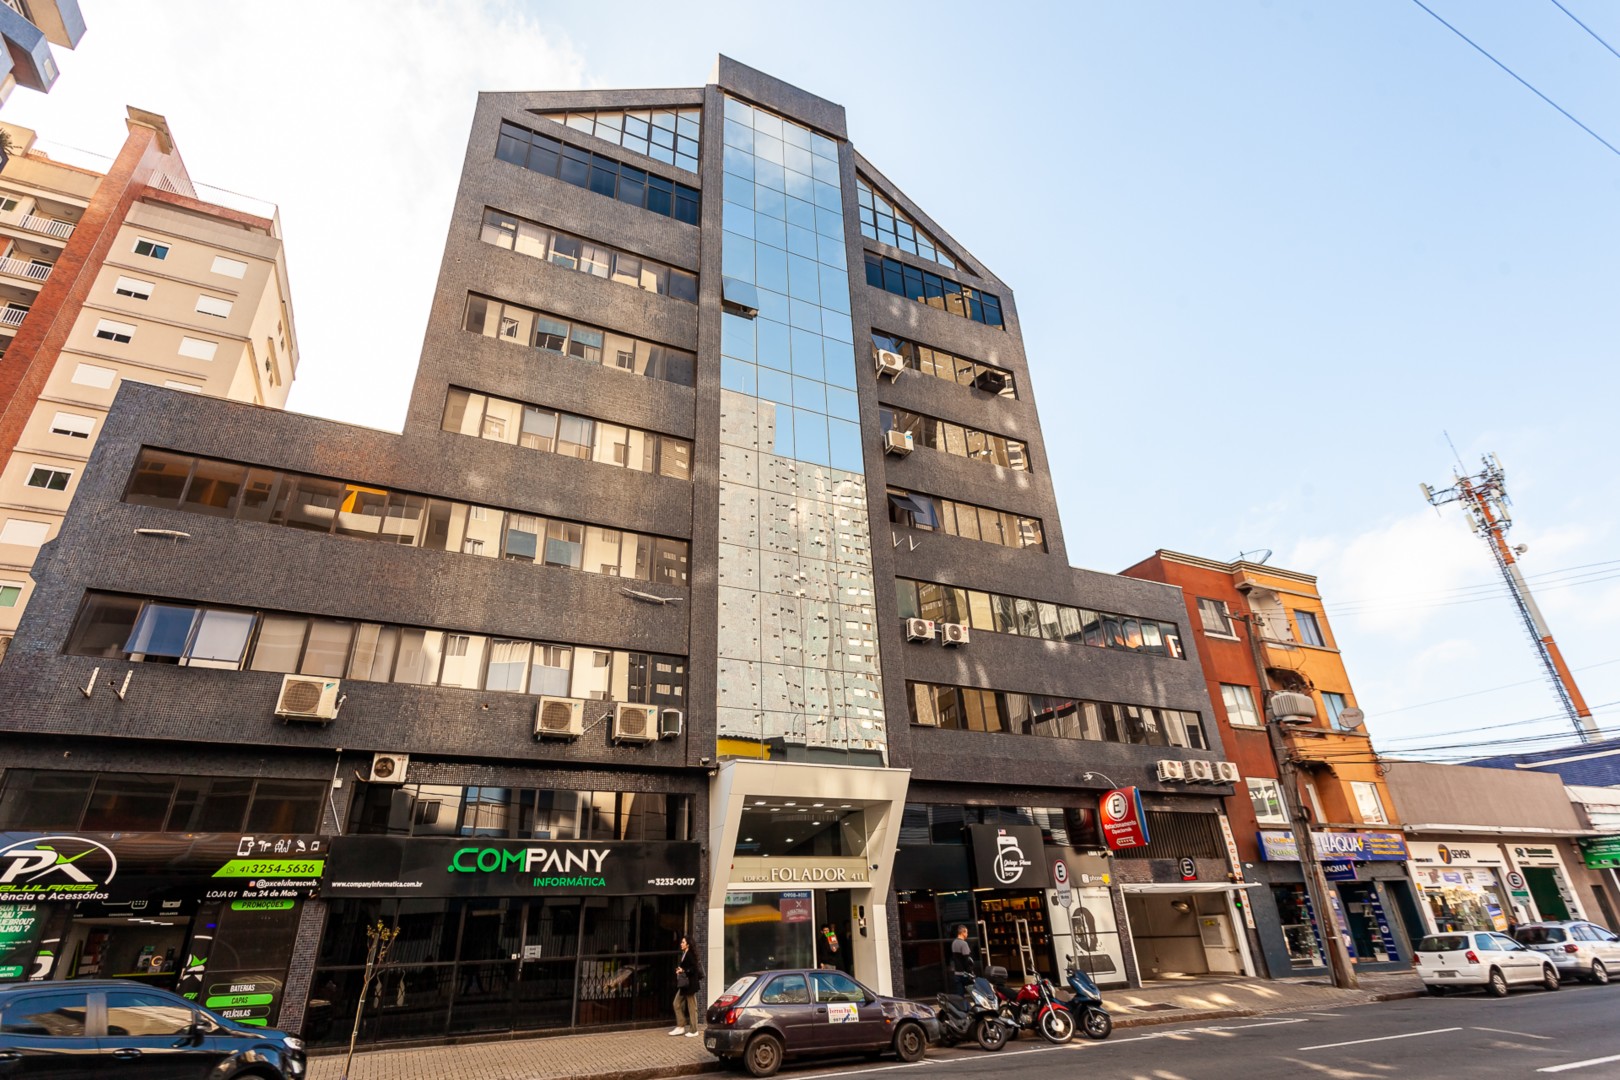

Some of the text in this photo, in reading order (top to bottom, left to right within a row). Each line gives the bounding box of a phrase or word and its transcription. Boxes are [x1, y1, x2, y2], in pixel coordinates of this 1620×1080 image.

[1113, 799, 1121, 814] E
[1320, 836, 1363, 852] HAQUA
[1450, 850, 1471, 859] SEVEN
[251, 864, 315, 874] 3254-5636
[1057, 865, 1064, 878] E
[1182, 861, 1192, 874] E
[1222, 818, 1253, 925] ESTACIONENTO
[771, 867, 846, 882] FOLADOR
[851, 873, 864, 881] 411
[533, 875, 606, 887] INFORMÁTICA
[655, 877, 695, 886] 3233-0017
[1511, 875, 1519, 885] E
[0, 892, 35, 901] ência
[48, 891, 109, 900] Acessórios
[17, 904, 37, 912] TELA
[0, 918, 35, 926] UEBROU?
[230, 984, 255, 992] BATERIAS
[222, 1009, 251, 1018] PELÍCULAS
